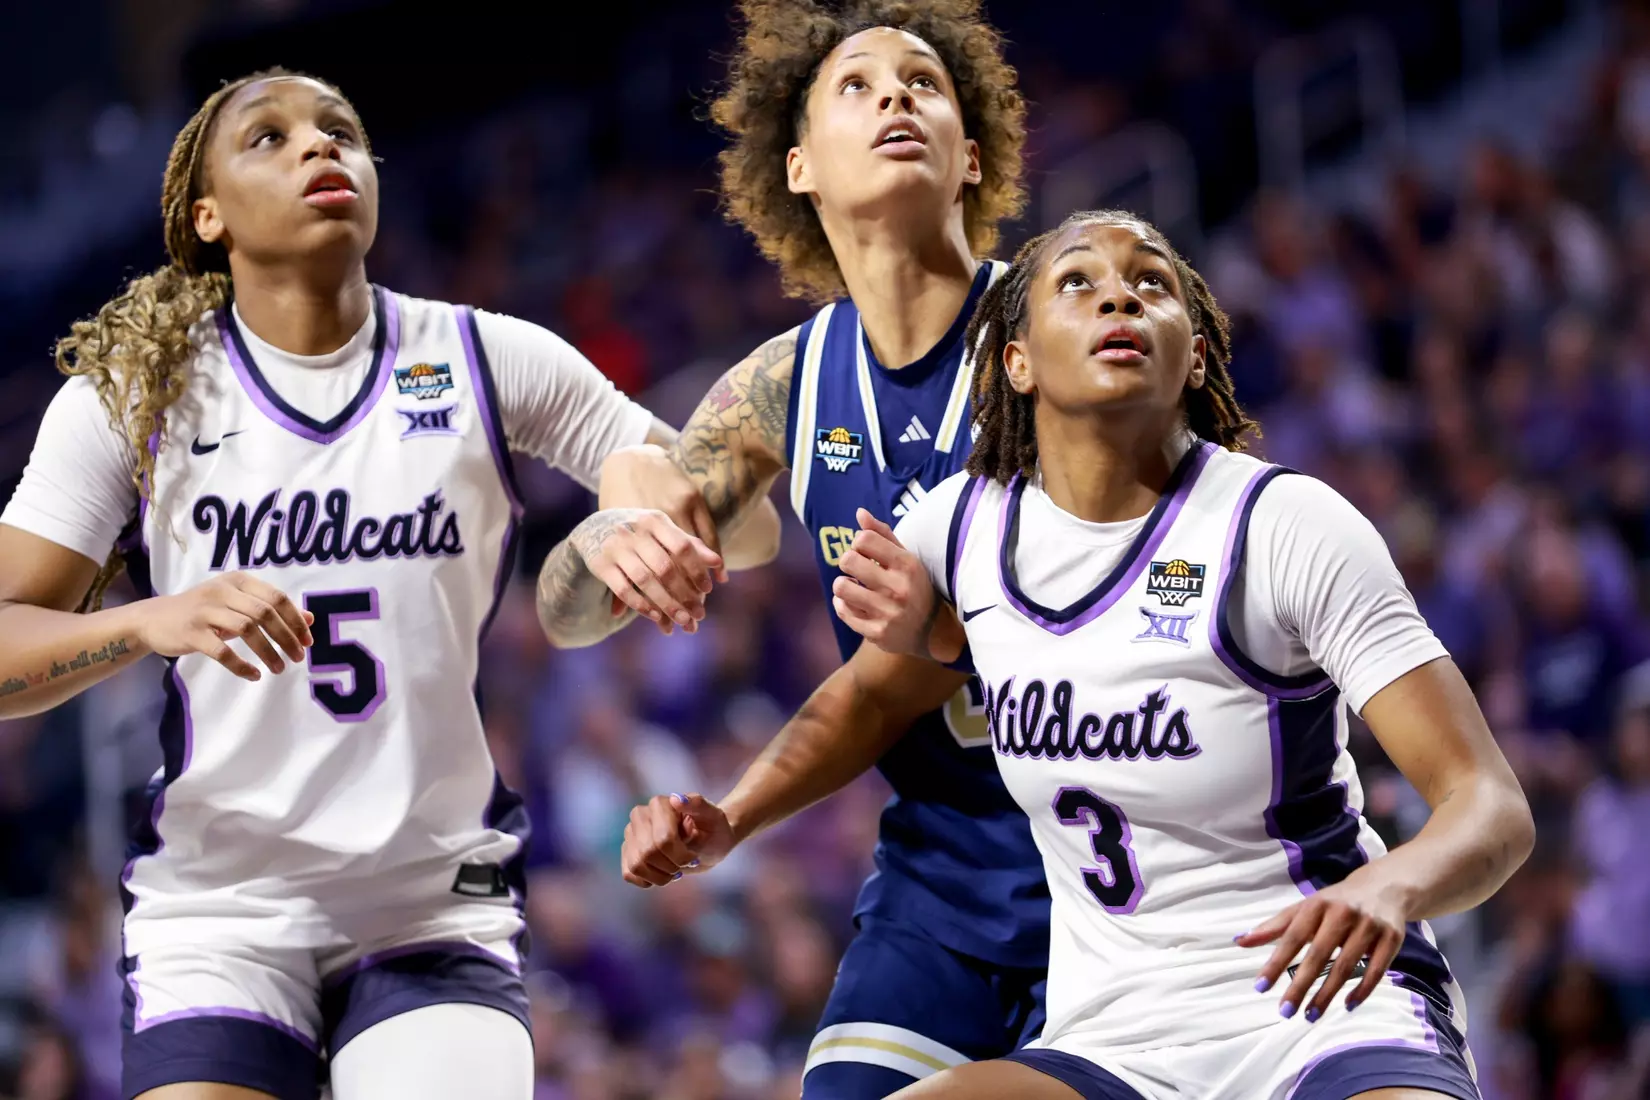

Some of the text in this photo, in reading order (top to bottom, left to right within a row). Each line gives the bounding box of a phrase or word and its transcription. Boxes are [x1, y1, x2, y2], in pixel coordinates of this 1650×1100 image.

[397, 373, 451, 388] WBIT
[396, 403, 459, 434] XII
[817, 440, 862, 458] WBIT
[193, 488, 464, 571] Wildcats
[1150, 575, 1202, 590] WBIT
[1136, 607, 1196, 643] XII
[302, 586, 387, 723] 5
[1051, 786, 1146, 914] 3
